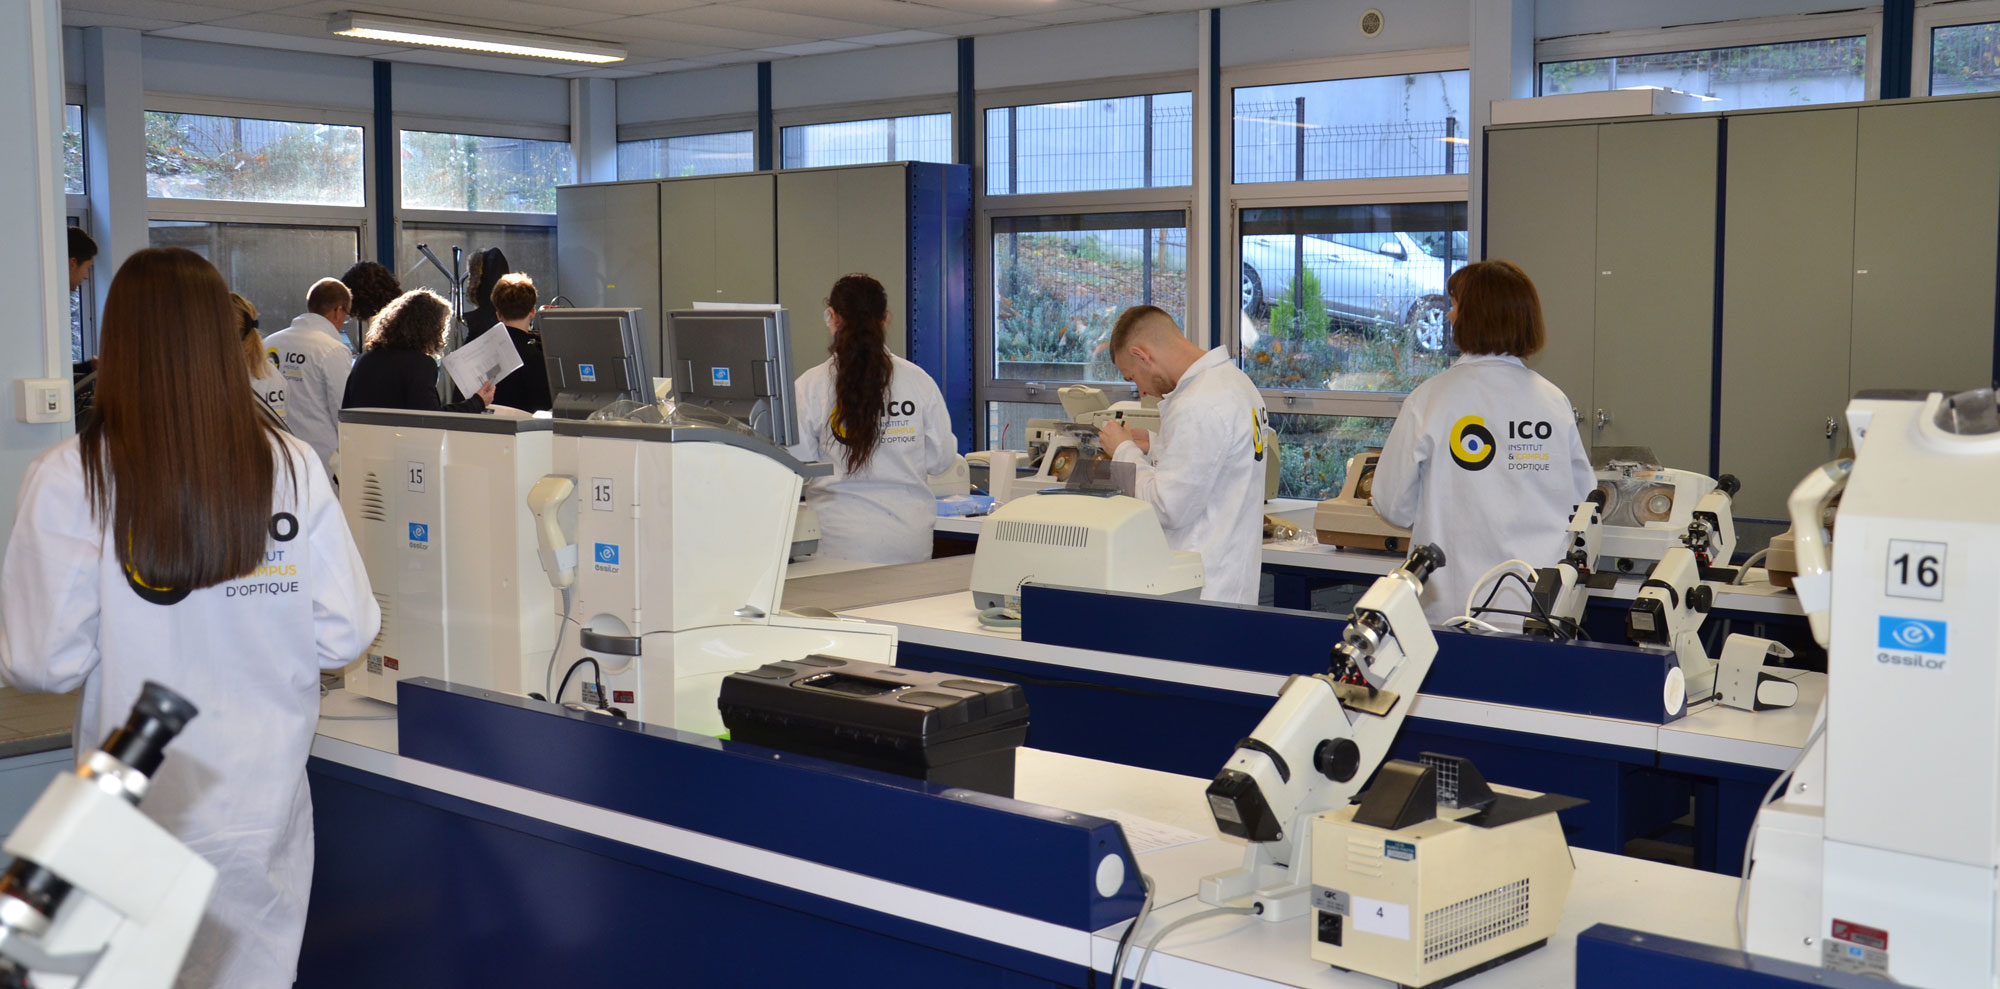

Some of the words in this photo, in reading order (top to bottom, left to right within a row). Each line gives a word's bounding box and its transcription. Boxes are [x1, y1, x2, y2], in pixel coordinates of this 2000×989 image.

[285, 352, 306, 365] ICO
[1508, 420, 1553, 440] ICO
[880, 436, 916, 444] D'OPTIQUE
[1508, 444, 1543, 452] INSTITUT
[1508, 453, 1515, 461] &
[1515, 453, 1550, 462] CAMPUS
[1508, 463, 1550, 472] D'OPTIQUE
[409, 468, 423, 484] 15
[594, 485, 611, 502] 15
[240, 564, 297, 579] AMPUS
[1893, 552, 1939, 588] 16
[226, 581, 299, 597] D'OPTIQUE
[1876, 652, 1947, 670] essilor
[1376, 906, 1384, 918] 4
